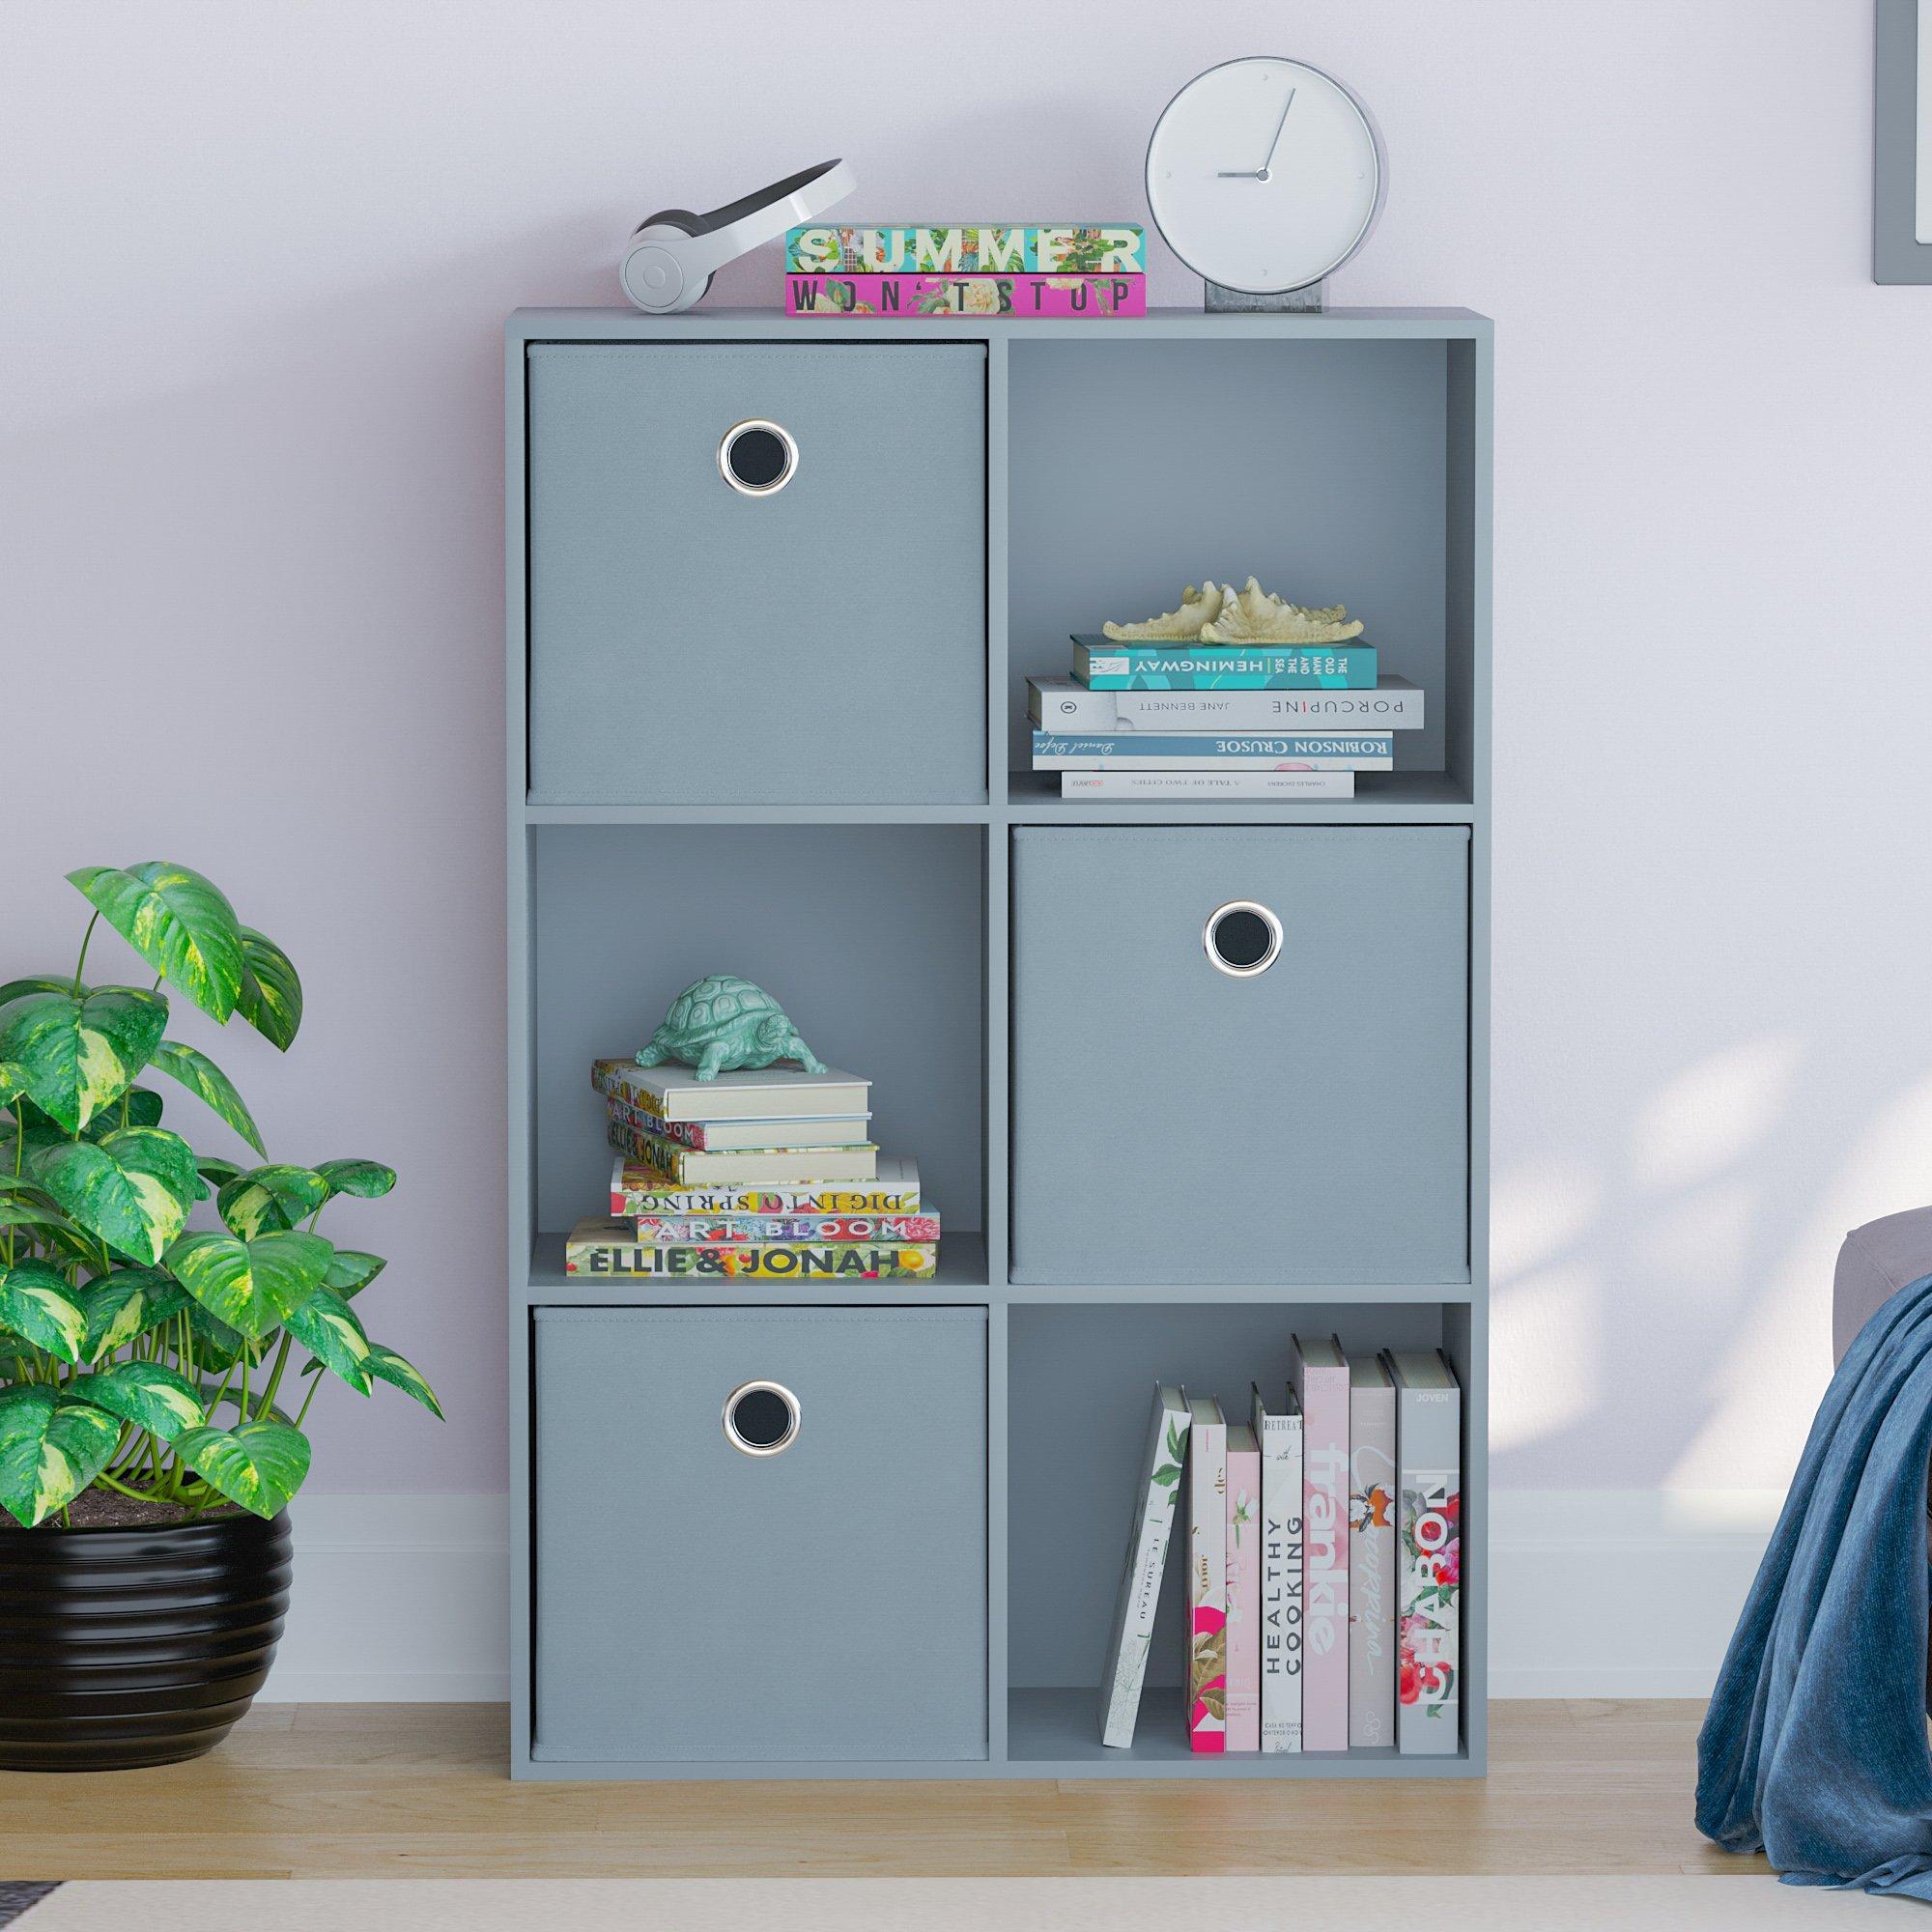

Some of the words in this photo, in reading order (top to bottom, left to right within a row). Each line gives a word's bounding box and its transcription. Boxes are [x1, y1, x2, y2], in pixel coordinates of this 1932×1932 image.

[798, 228, 1142, 272] SUMMER
[1135, 660, 1264, 672] HEMINGWAY
[1275, 657, 1286, 674] SEA
[1288, 657, 1297, 674] THE
[1300, 656, 1310, 675] AND
[1313, 656, 1322, 675] MAN
[1324, 656, 1335, 675] OLD
[1338, 657, 1348, 674] THE
[1139, 702, 1196, 711] BENNETT
[1200, 702, 1232, 711] JANE
[1272, 700, 1404, 713] PORCUPINE
[1035, 736, 1068, 755] Defoe
[1068, 742, 1115, 755] Daniel
[646, 1118, 694, 1140] BLOOM
[640, 1193, 750, 1211] SPRING
[766, 1193, 840, 1210] INTO
[850, 1193, 903, 1210] DIG
[655, 1220, 739, 1239] ART
[765, 1220, 909, 1237] BLOOM
[742, 1248, 900, 1274] JONAH
[1415, 1392, 1449, 1403] JOVEN
[1309, 1442, 1350, 1657] frankie
[1139, 1562, 1156, 1620] SUREAU
[1266, 1519, 1281, 1674] HEALTHY
[1286, 1517, 1303, 1676] COOKING
